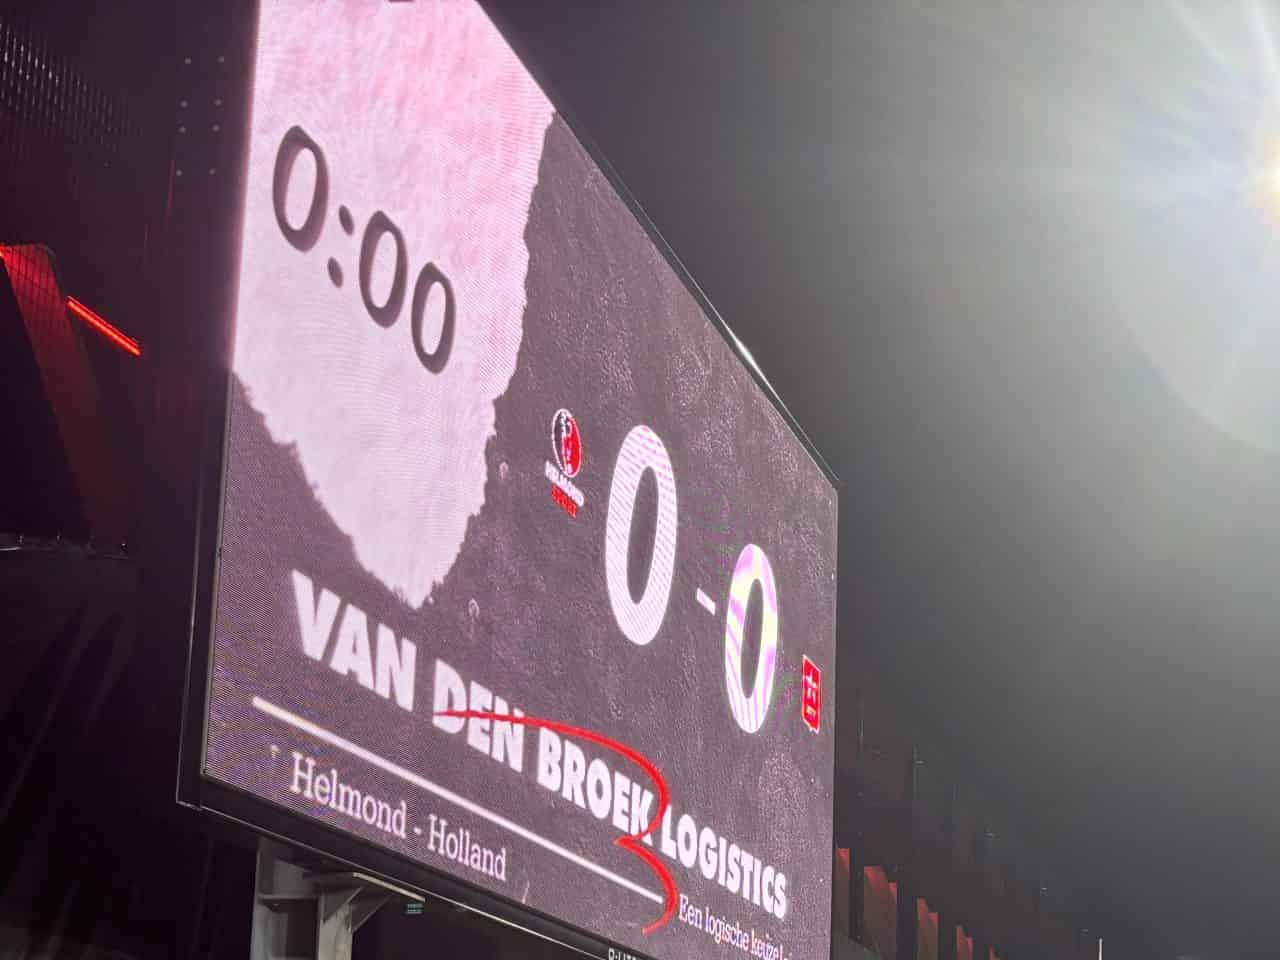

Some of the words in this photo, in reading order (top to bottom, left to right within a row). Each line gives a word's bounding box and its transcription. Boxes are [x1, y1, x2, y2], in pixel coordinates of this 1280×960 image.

[272, 125, 455, 375] 0:00
[605, 425, 678, 646] 0
[725, 544, 778, 734] 0
[289, 751, 407, 840] Helmond
[427, 814, 507, 881] Holland
[291, 568, 417, 713] VAN
[432, 658, 526, 773] DEN
[537, 726, 655, 846] BROEK
[660, 804, 788, 920] LOGISTICS
[679, 893, 703, 929] Een
[705, 906, 749, 951] logische
